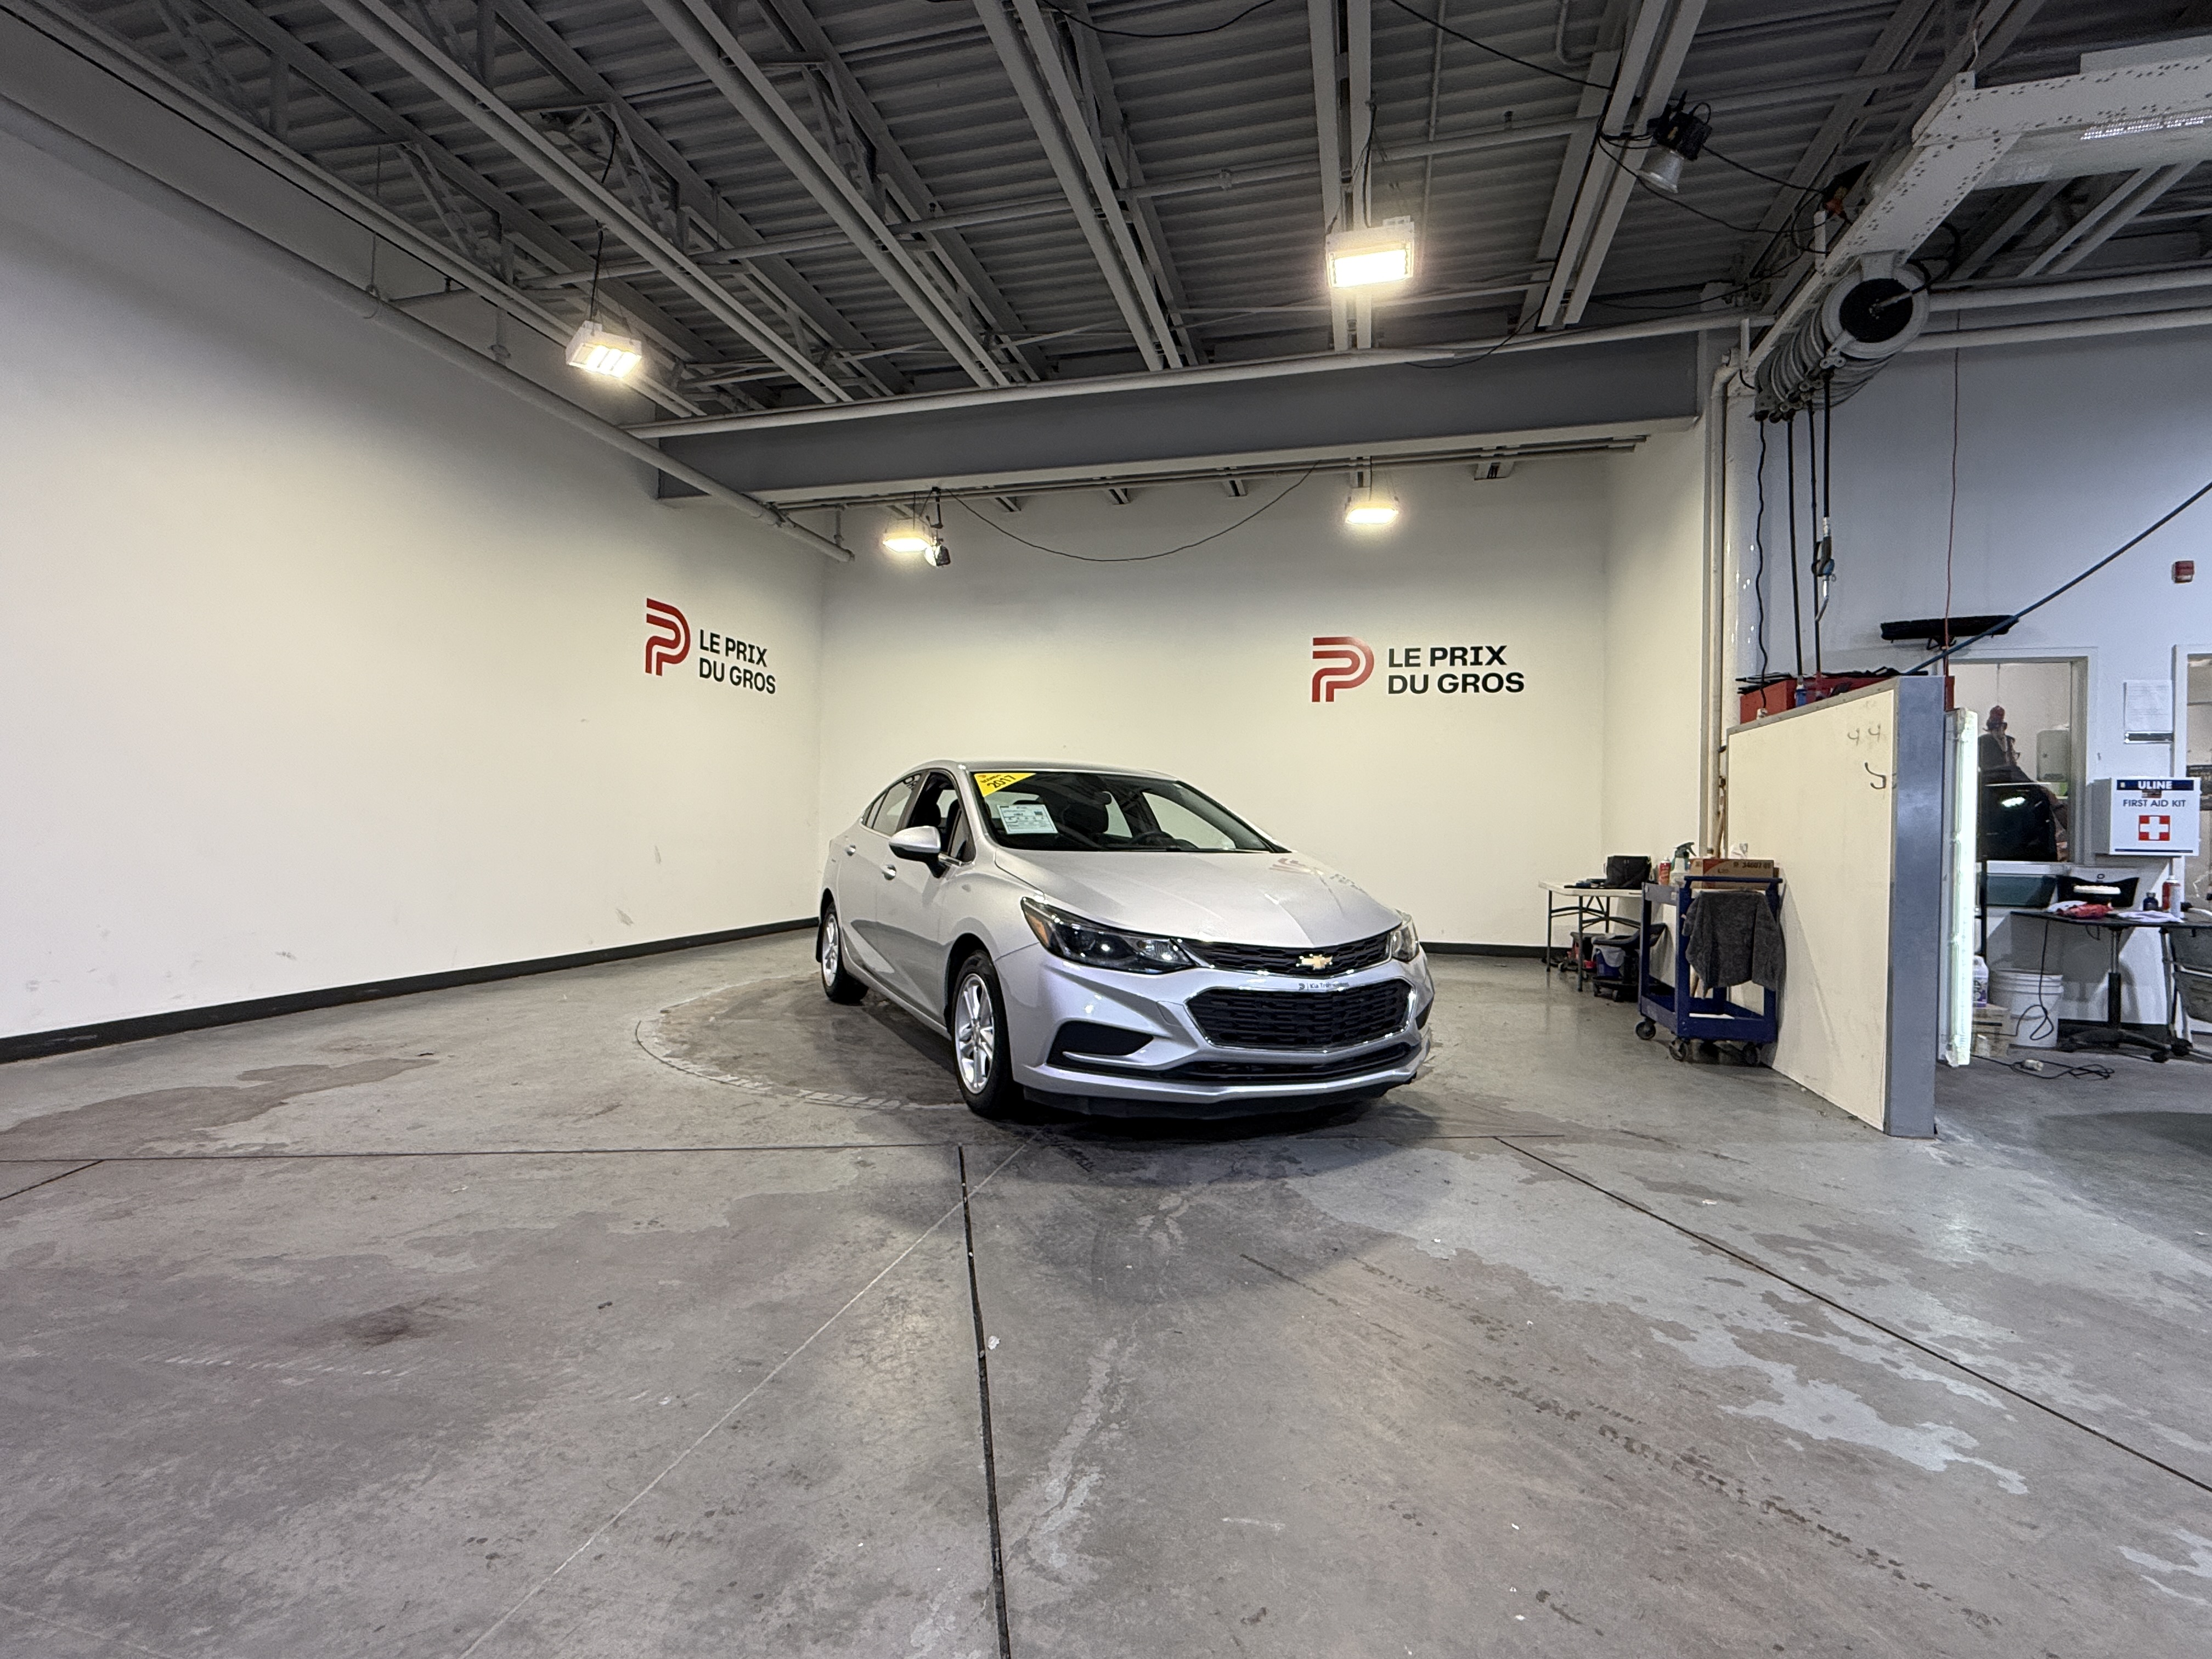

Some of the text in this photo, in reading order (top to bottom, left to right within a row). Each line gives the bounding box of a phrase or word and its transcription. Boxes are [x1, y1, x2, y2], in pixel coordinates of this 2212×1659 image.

[699, 629, 768, 667] LE PRIX
[1389, 645, 1507, 668] LE PRIX
[699, 657, 776, 695] DU GROS
[1388, 672, 1524, 695] DU GROS
[987, 775, 1016, 788] 2017
[2137, 781, 2172, 789] ULINE
